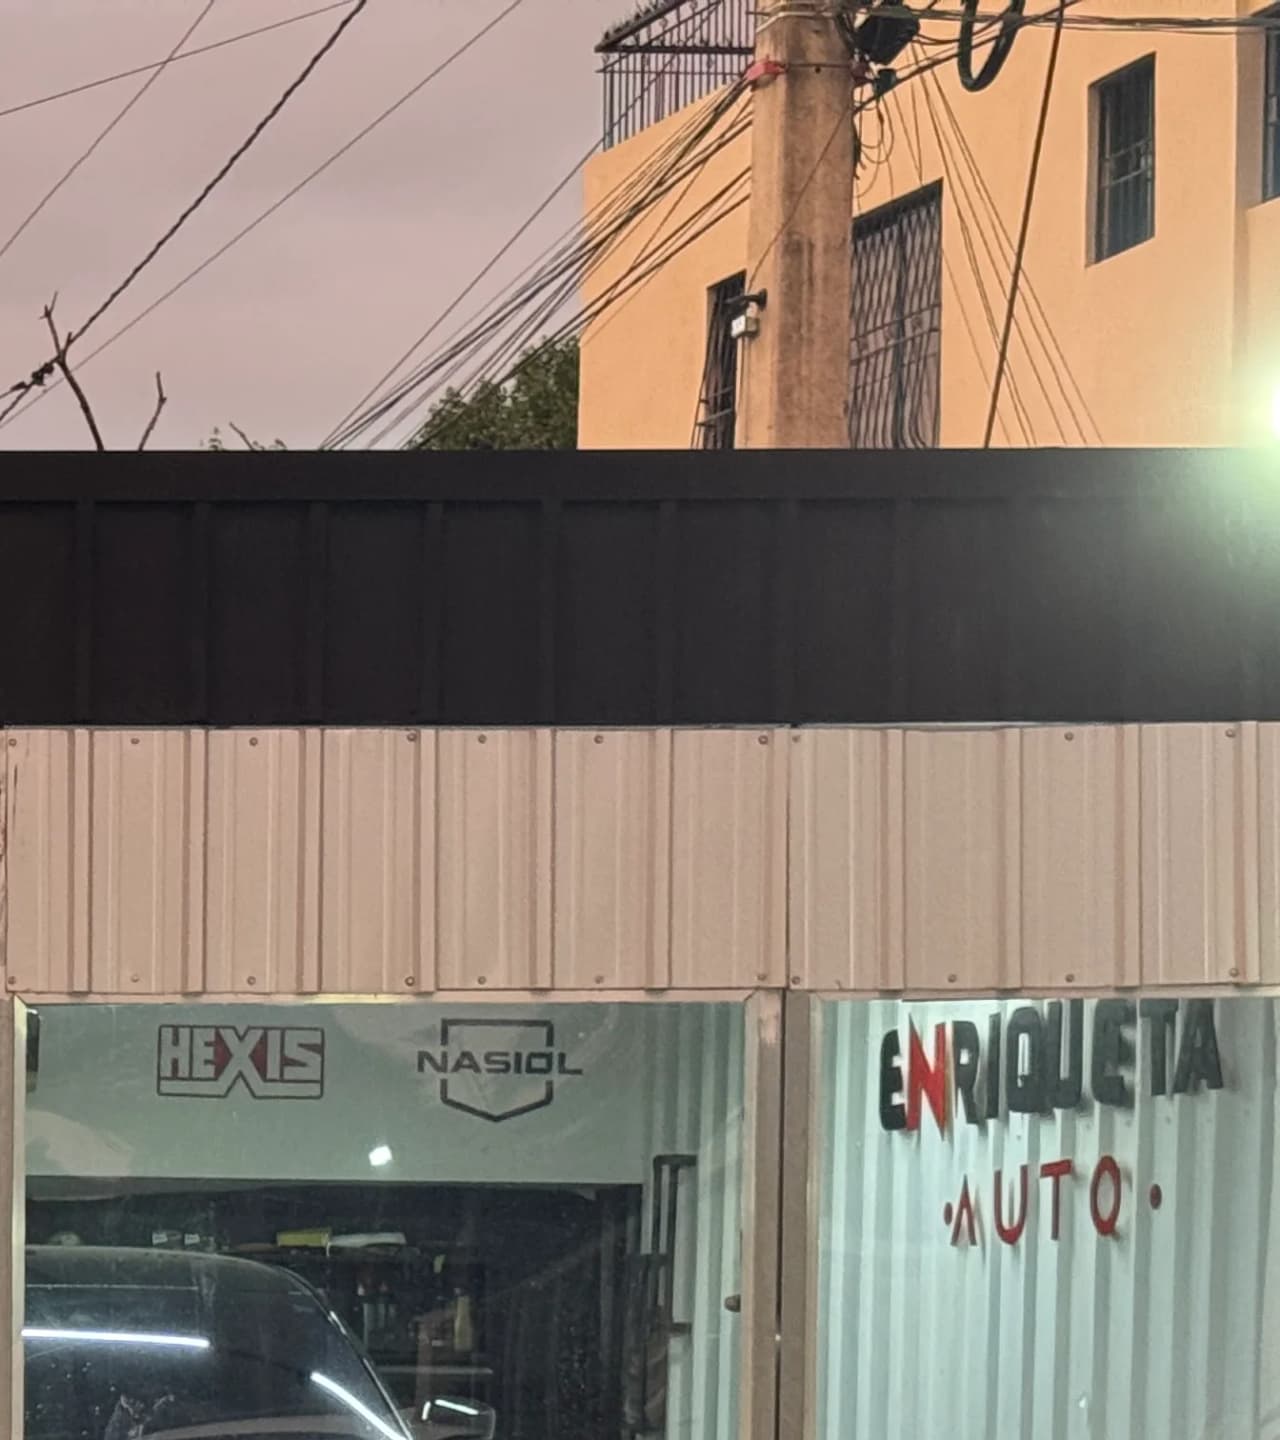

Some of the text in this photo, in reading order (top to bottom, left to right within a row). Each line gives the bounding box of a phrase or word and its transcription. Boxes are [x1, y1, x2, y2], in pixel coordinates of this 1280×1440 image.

[158, 1026, 324, 1098] HEXIS
[417, 1049, 583, 1076] NASIOL
[879, 998, 1224, 1140] ENRIQUETA
[950, 1154, 1122, 1246] AUTO
